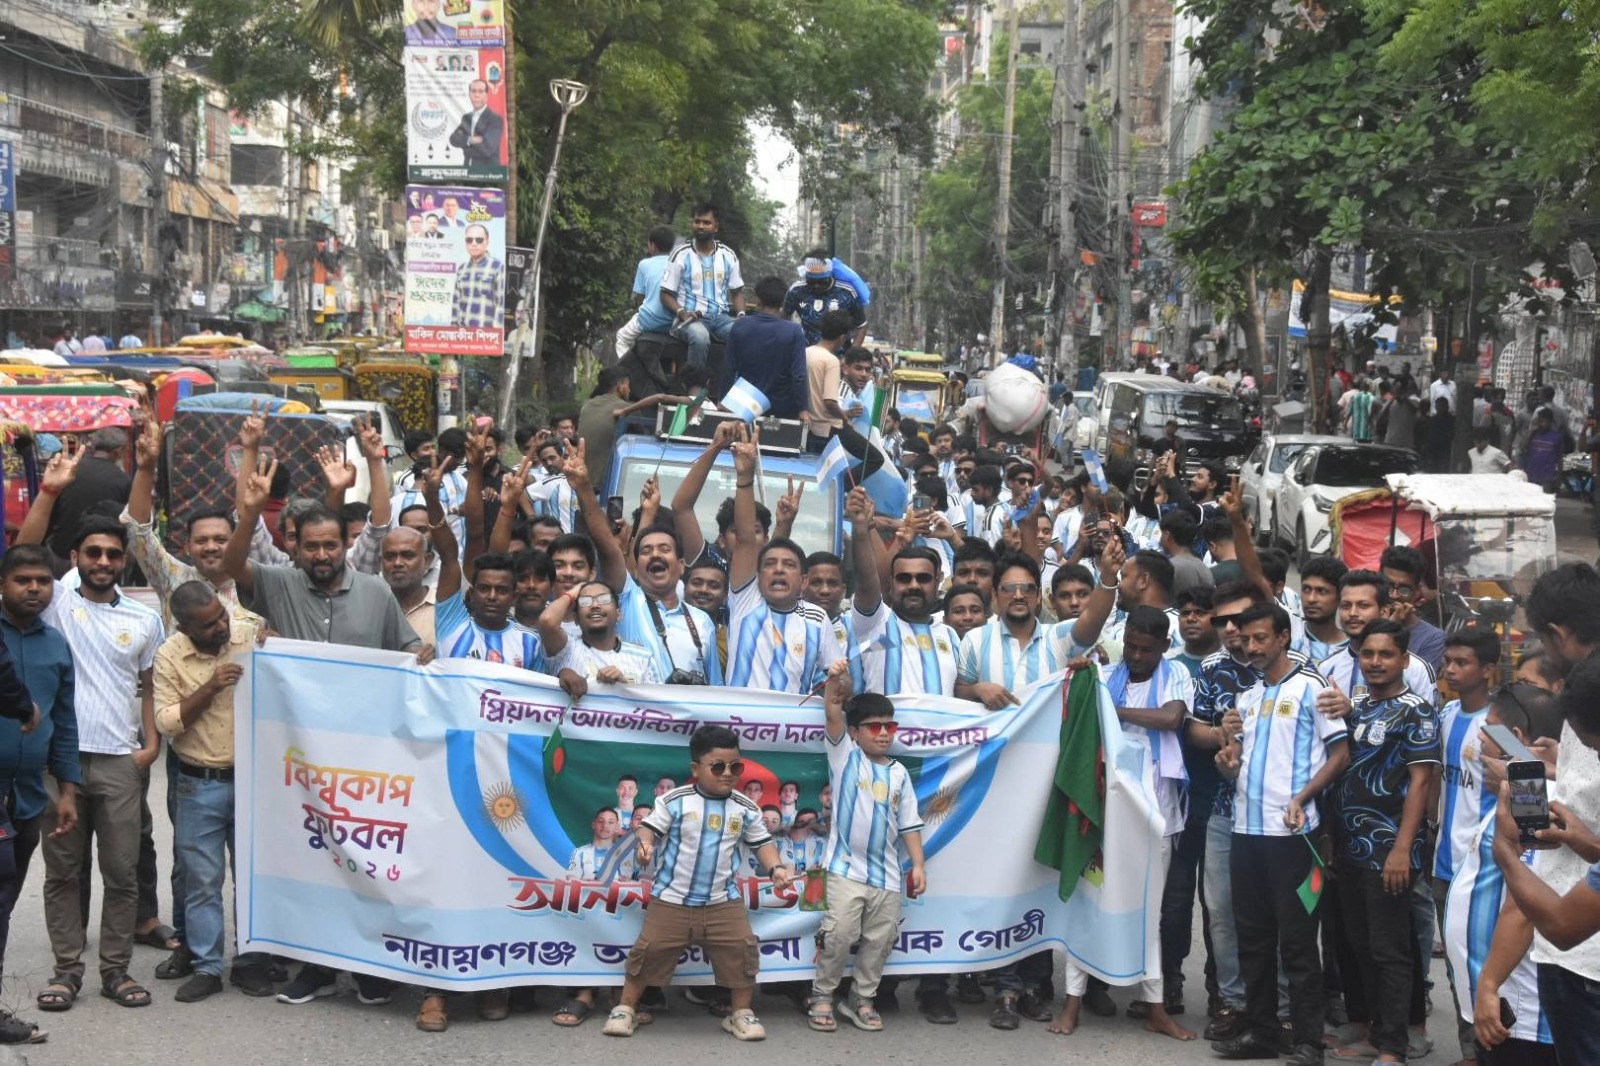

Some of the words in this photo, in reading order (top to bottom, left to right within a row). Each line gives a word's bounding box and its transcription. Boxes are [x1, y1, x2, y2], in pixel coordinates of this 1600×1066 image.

[479, 689, 567, 725] প্রিয়দল
[283, 746, 415, 813] বিশ্বকাপ
[302, 804, 408, 854] ফুটবল
[382, 933, 577, 974] নারায়ণগঞ্জ
[958, 908, 1045, 952] গোষ্ঠী
